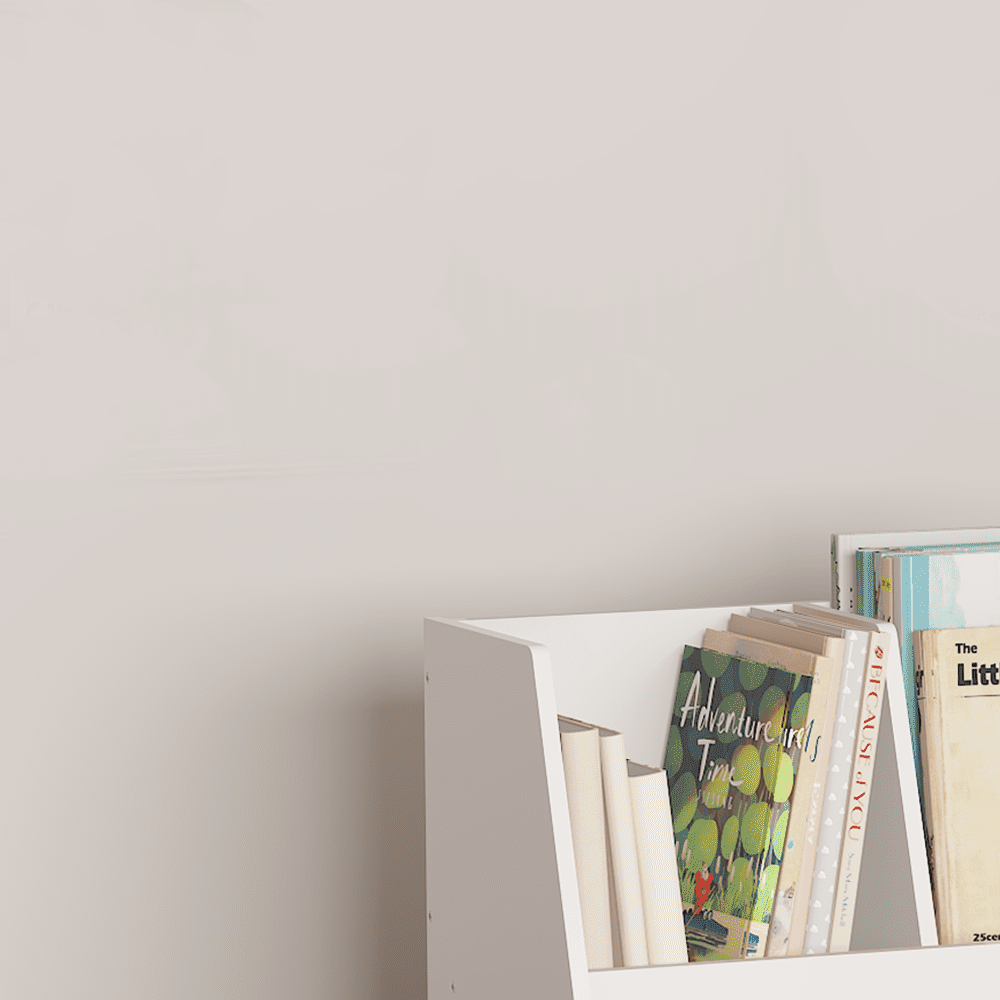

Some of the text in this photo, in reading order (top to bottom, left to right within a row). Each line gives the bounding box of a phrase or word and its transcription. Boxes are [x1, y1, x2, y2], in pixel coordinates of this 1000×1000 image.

[955, 642, 979, 655] The
[680, 670, 776, 743] Adventure
[697, 738, 745, 787] Time
[847, 791, 867, 843] YOU
